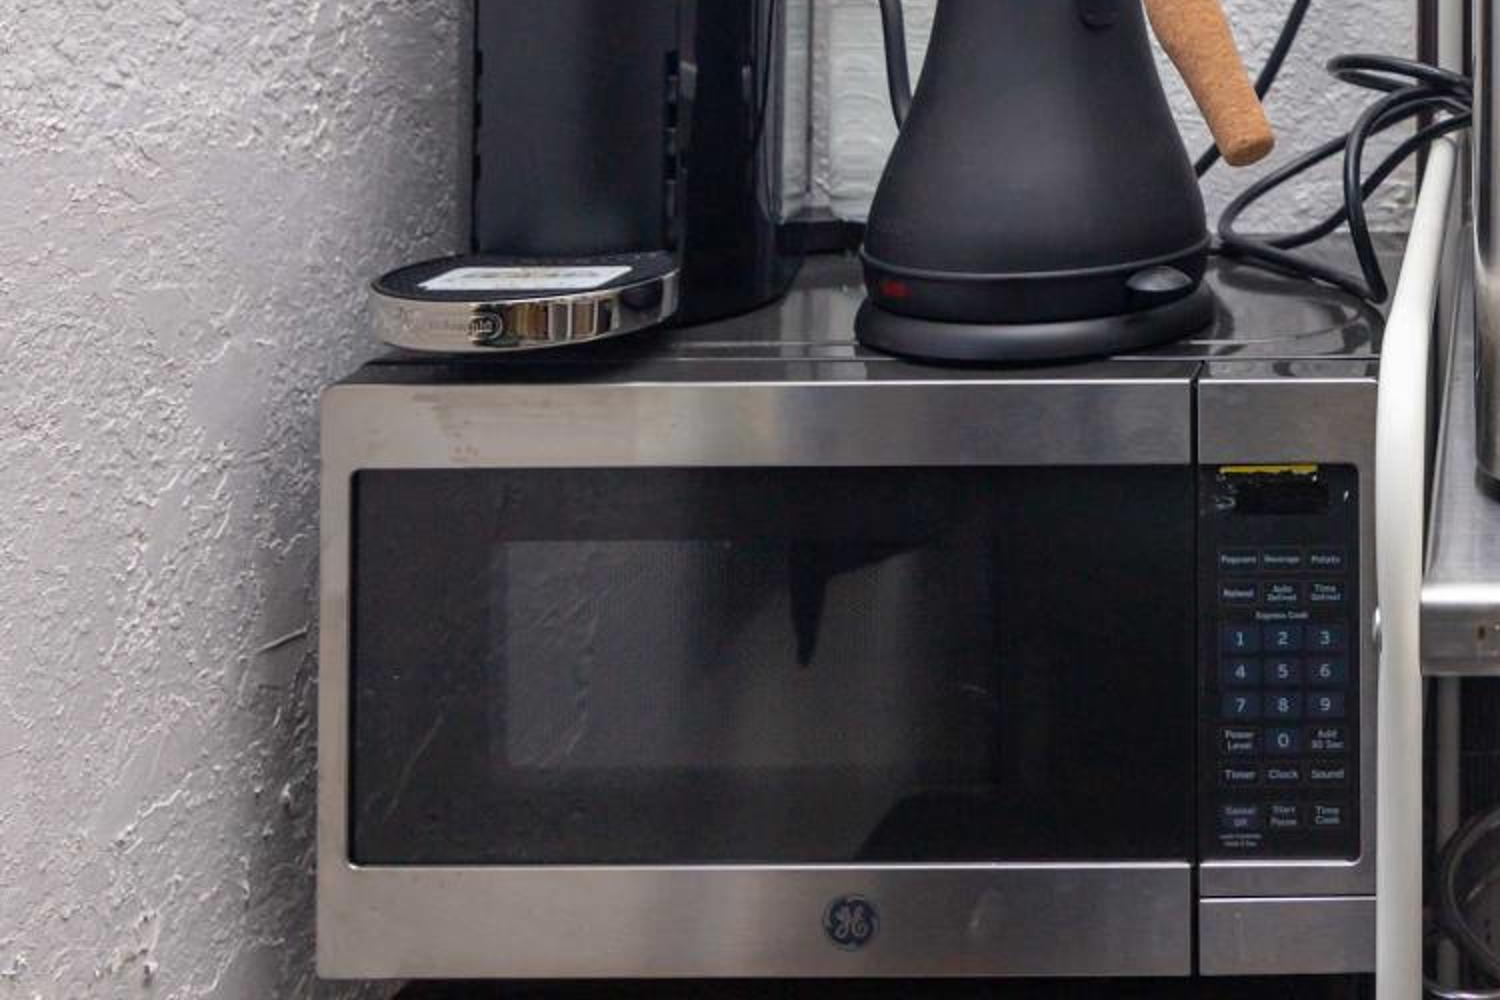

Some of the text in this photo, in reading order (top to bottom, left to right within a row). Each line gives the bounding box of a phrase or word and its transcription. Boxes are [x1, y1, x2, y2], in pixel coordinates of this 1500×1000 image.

[1235, 631, 1245, 646] 1
[1277, 631, 1289, 646] 2
[1319, 630, 1331, 646] 3
[1234, 664, 1246, 679] 4
[1277, 663, 1289, 679] 5
[1319, 663, 1332, 678] 6
[1235, 697, 1247, 713] 7
[1278, 697, 1289, 713] 8
[1319, 697, 1332, 712] 9
[1277, 732, 1290, 748] 0
[1267, 769, 1299, 780] Clock
[1311, 769, 1345, 780] Sound
